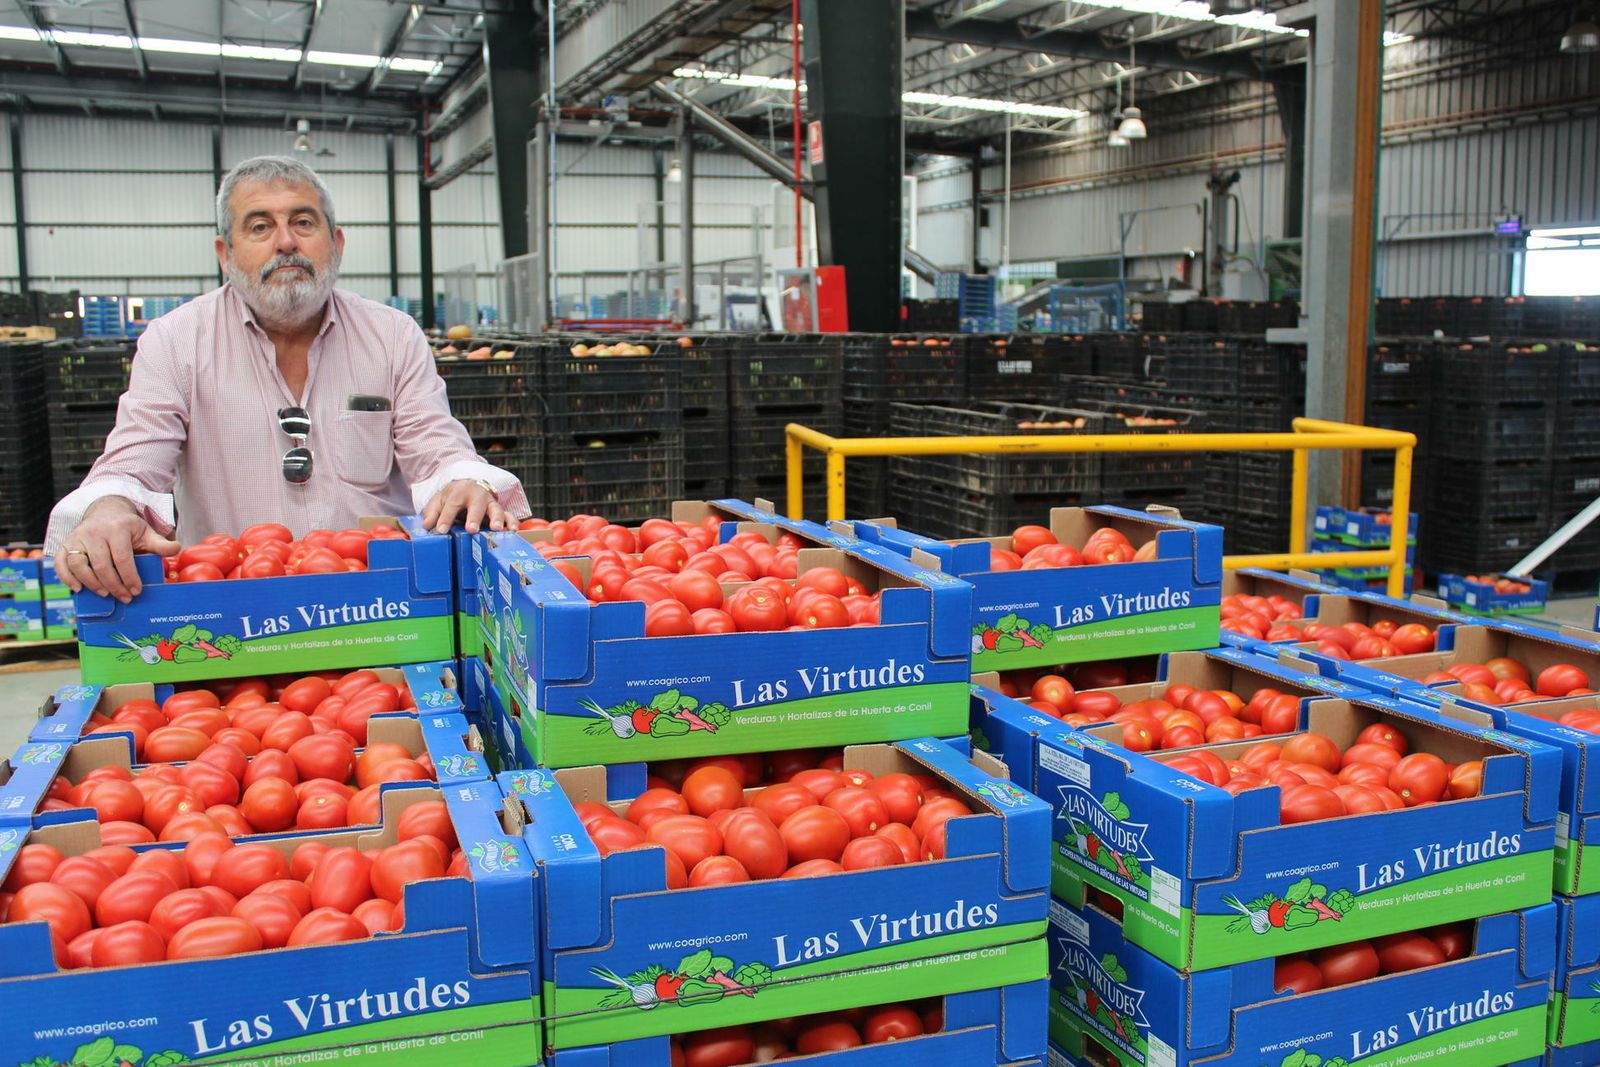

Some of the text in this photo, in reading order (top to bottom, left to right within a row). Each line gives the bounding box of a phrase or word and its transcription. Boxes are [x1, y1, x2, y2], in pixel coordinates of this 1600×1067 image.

[150, 612, 222, 624] www.coagrico.com
[240, 597, 411, 639] Las Virtudes
[1053, 586, 1190, 628] Las Virtudes
[245, 642, 282, 654] Verduras
[291, 639, 330, 650] Hortalizas
[355, 634, 383, 645] Huerta
[397, 632, 419, 642] Conil
[1056, 632, 1087, 643] Verduras
[1092, 628, 1126, 640] Hortalizas
[1145, 624, 1168, 635] Huerta
[1179, 621, 1196, 631] Conil
[626, 674, 711, 688] www.coagrico.com
[730, 659, 925, 708] Las Virtudes
[735, 714, 777, 726] Verduras
[787, 710, 832, 722] Hortalizas
[861, 704, 892, 715] Huerta
[908, 702, 932, 713] Conil
[1068, 794, 1138, 853] LAS VIRTUDES
[1265, 860, 1339, 880] www.coagrico.com
[1356, 831, 1521, 893] Las Virtudes
[1358, 897, 1393, 911] Verduras
[1402, 888, 1441, 903] Hortalizas
[1465, 877, 1492, 892] Huerta
[1505, 872, 1525, 884] Conil
[648, 931, 748, 952] www.coagrico.com
[772, 900, 999, 967] Las Virtudes
[926, 954, 960, 966] Huerta
[963, 951, 977, 961] de
[980, 945, 1008, 958] Conil
[1068, 948, 1135, 1017] LAS VIRTUDES
[34, 1015, 158, 1040] www.coagrico.com
[188, 977, 470, 1055] Las Virtudes
[1350, 990, 1515, 1060] Las Virtudes
[275, 1049, 339, 1067] Hortalizas
[343, 1046, 361, 1057] de
[365, 1044, 377, 1055] la
[382, 1038, 425, 1053] Huerta
[429, 1034, 446, 1046] de
[451, 1030, 484, 1044] Conil
[1260, 1030, 1333, 1053] www.coagrico.com
[1396, 1049, 1435, 1067] Hortalizas
[1436, 1045, 1447, 1056] de
[1458, 1038, 1484, 1051] Huerta
[1486, 1034, 1497, 1044] de
[1498, 1028, 1519, 1041] Conil
